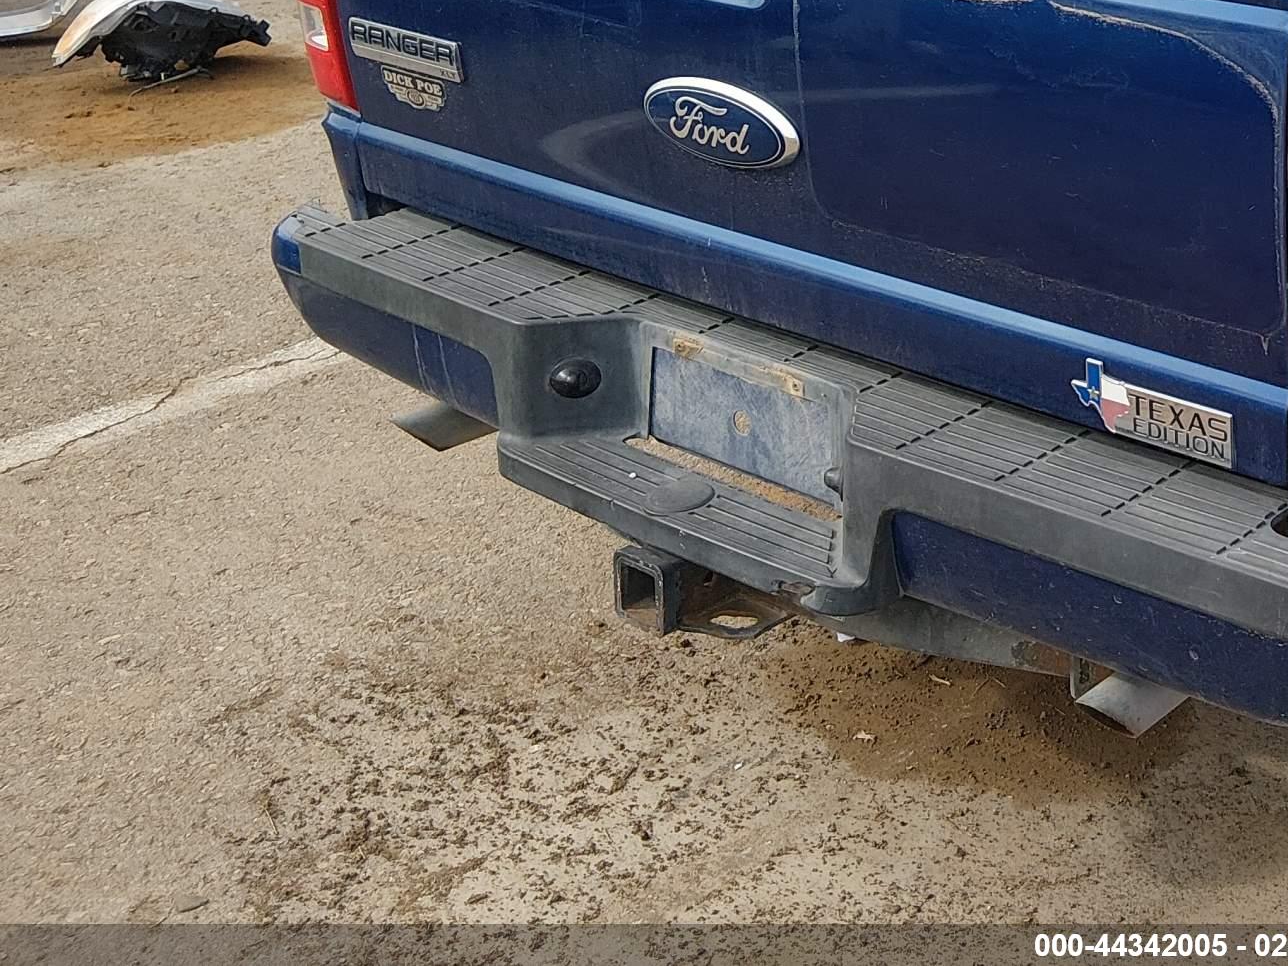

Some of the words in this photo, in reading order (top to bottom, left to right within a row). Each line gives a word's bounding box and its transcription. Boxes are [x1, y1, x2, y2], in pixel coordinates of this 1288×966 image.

[350, 22, 454, 67] RANGER
[383, 70, 414, 89] DICK
[415, 79, 443, 96] POE
[669, 96, 750, 155] Ford
[1127, 392, 1228, 443] TEXAS
[1132, 417, 1225, 459] EDITION
